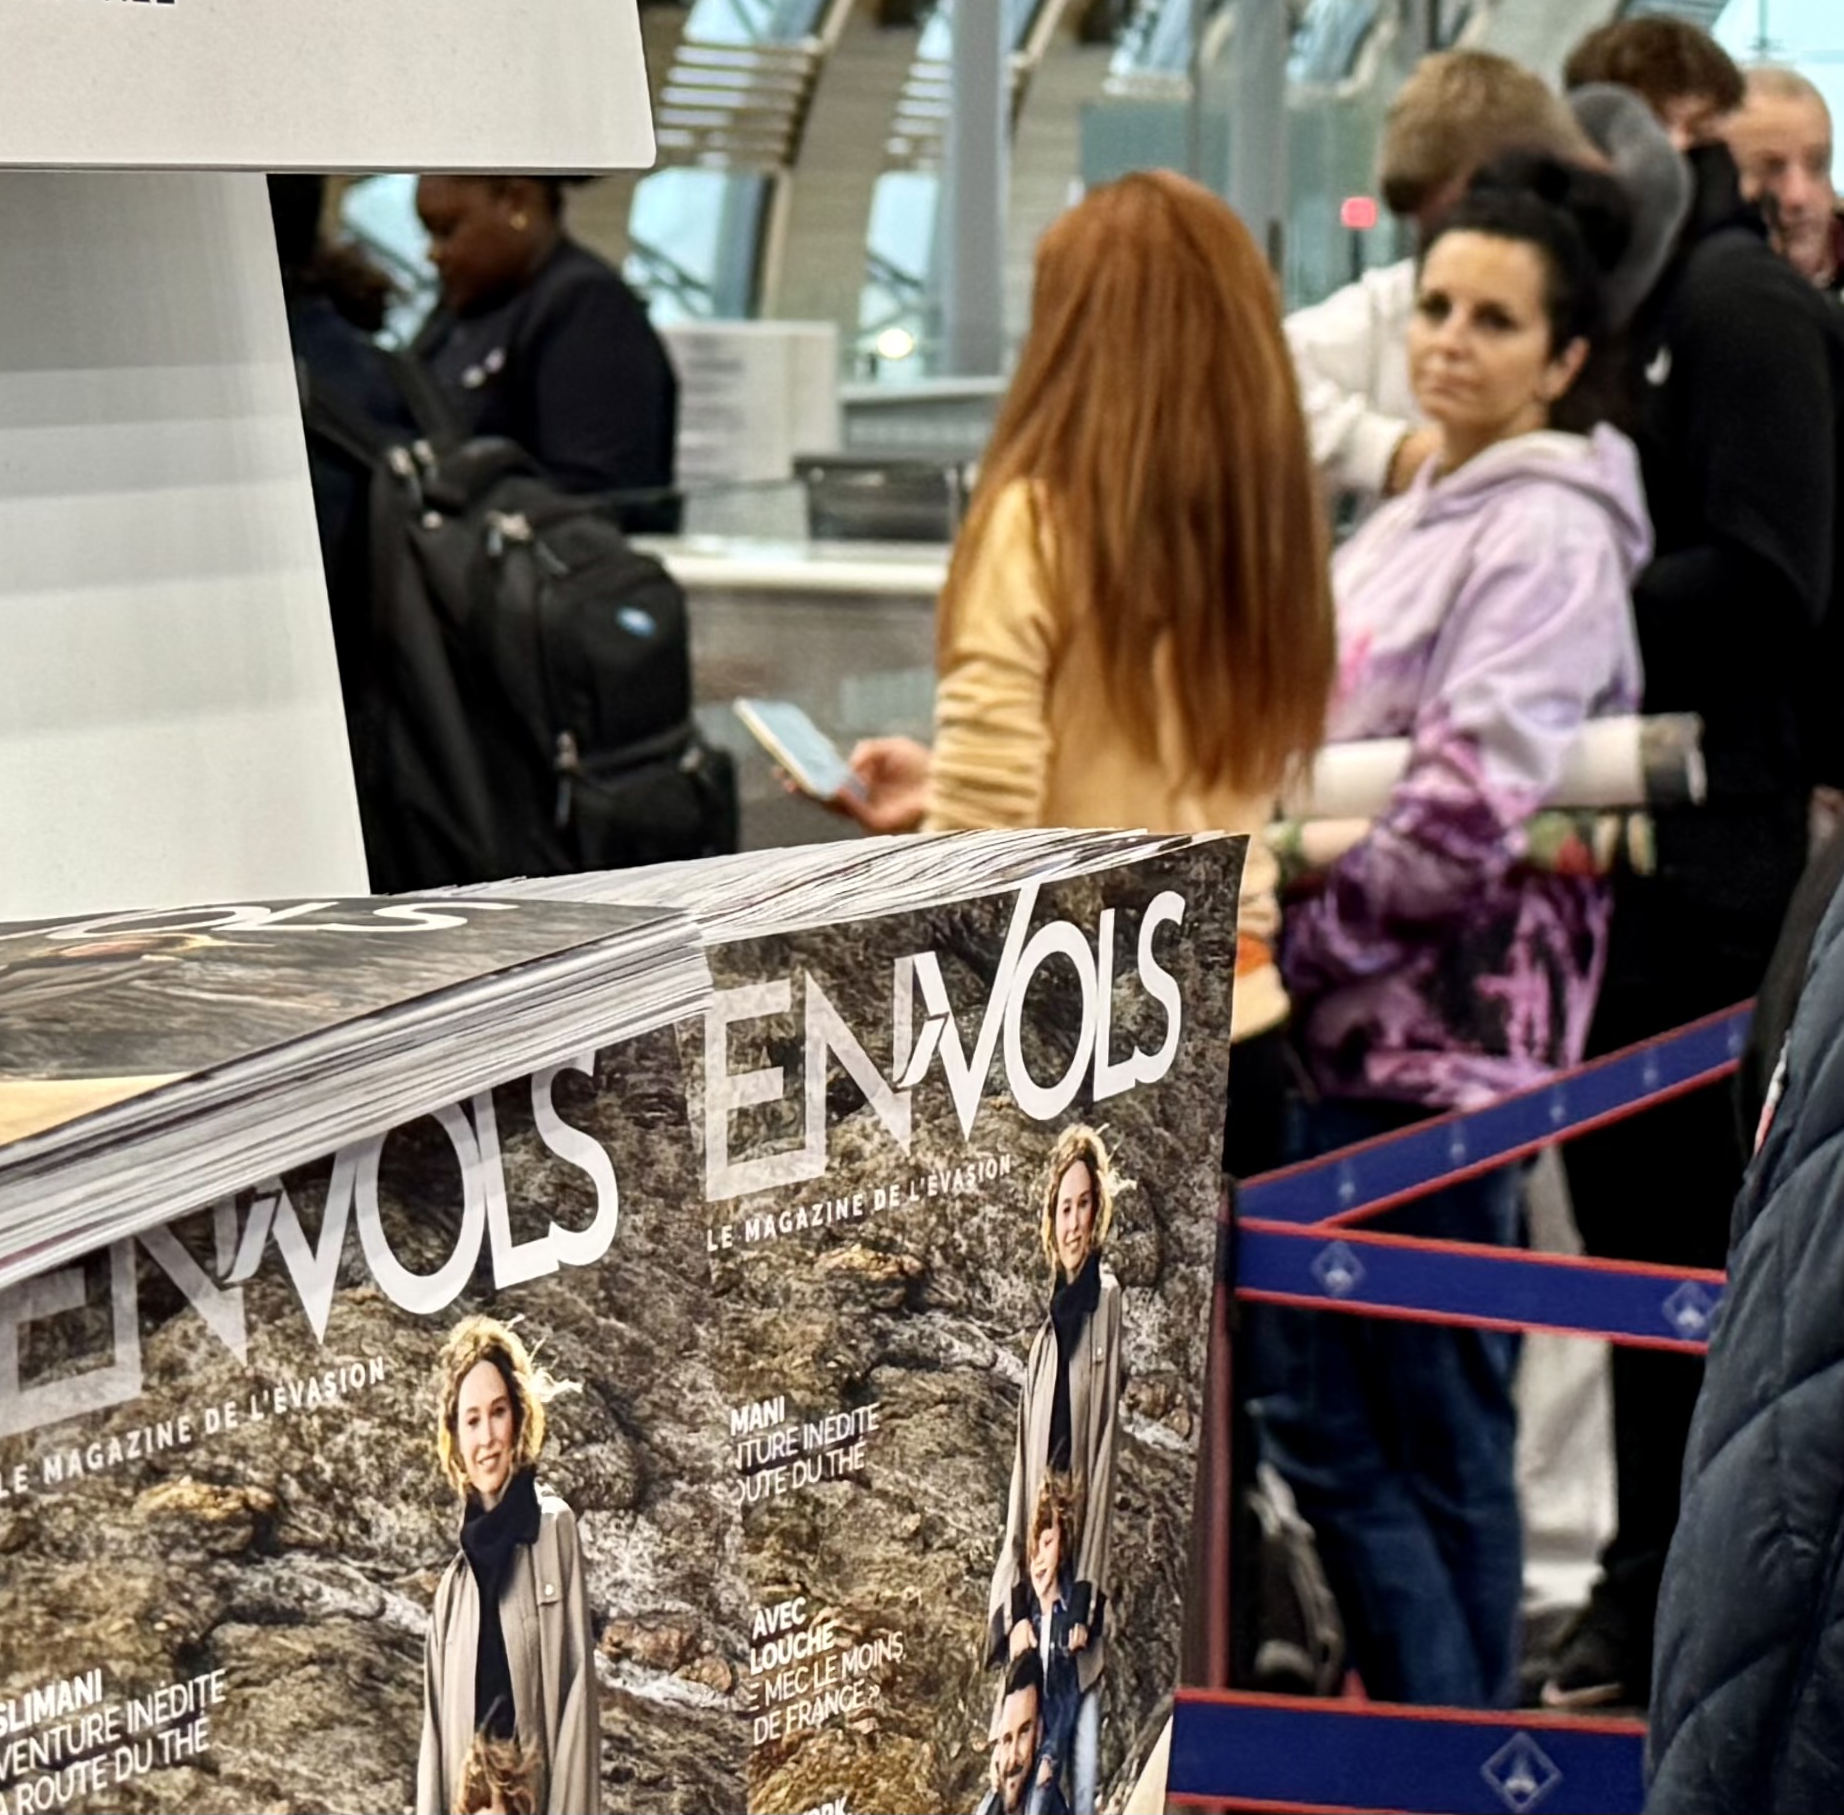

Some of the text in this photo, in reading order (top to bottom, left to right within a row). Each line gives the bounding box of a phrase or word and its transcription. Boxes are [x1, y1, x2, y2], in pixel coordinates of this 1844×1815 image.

[705, 874, 1185, 1202] ENVOLS
[707, 1225, 733, 1252] LE
[745, 1194, 863, 1243] MAGAZINE
[873, 1185, 900, 1211] DE
[730, 1395, 785, 1436] MANI
[803, 1401, 880, 1450] INÉDITE
[42, 1416, 191, 1485] MAGAZINE
[205, 1402, 237, 1434] DE
[792, 1454, 822, 1489] DU
[826, 1435, 867, 1477] THÉ
[752, 1596, 807, 1640] AVEC
[126, 1668, 226, 1734] INÉDITE
[765, 1666, 808, 1707] MEC
[813, 1655, 837, 1690] LE
[753, 1709, 781, 1746] DE
[16, 1754, 107, 1815] ROUTE
[114, 1739, 153, 1783] DU
[157, 1710, 210, 1764] THÉ
